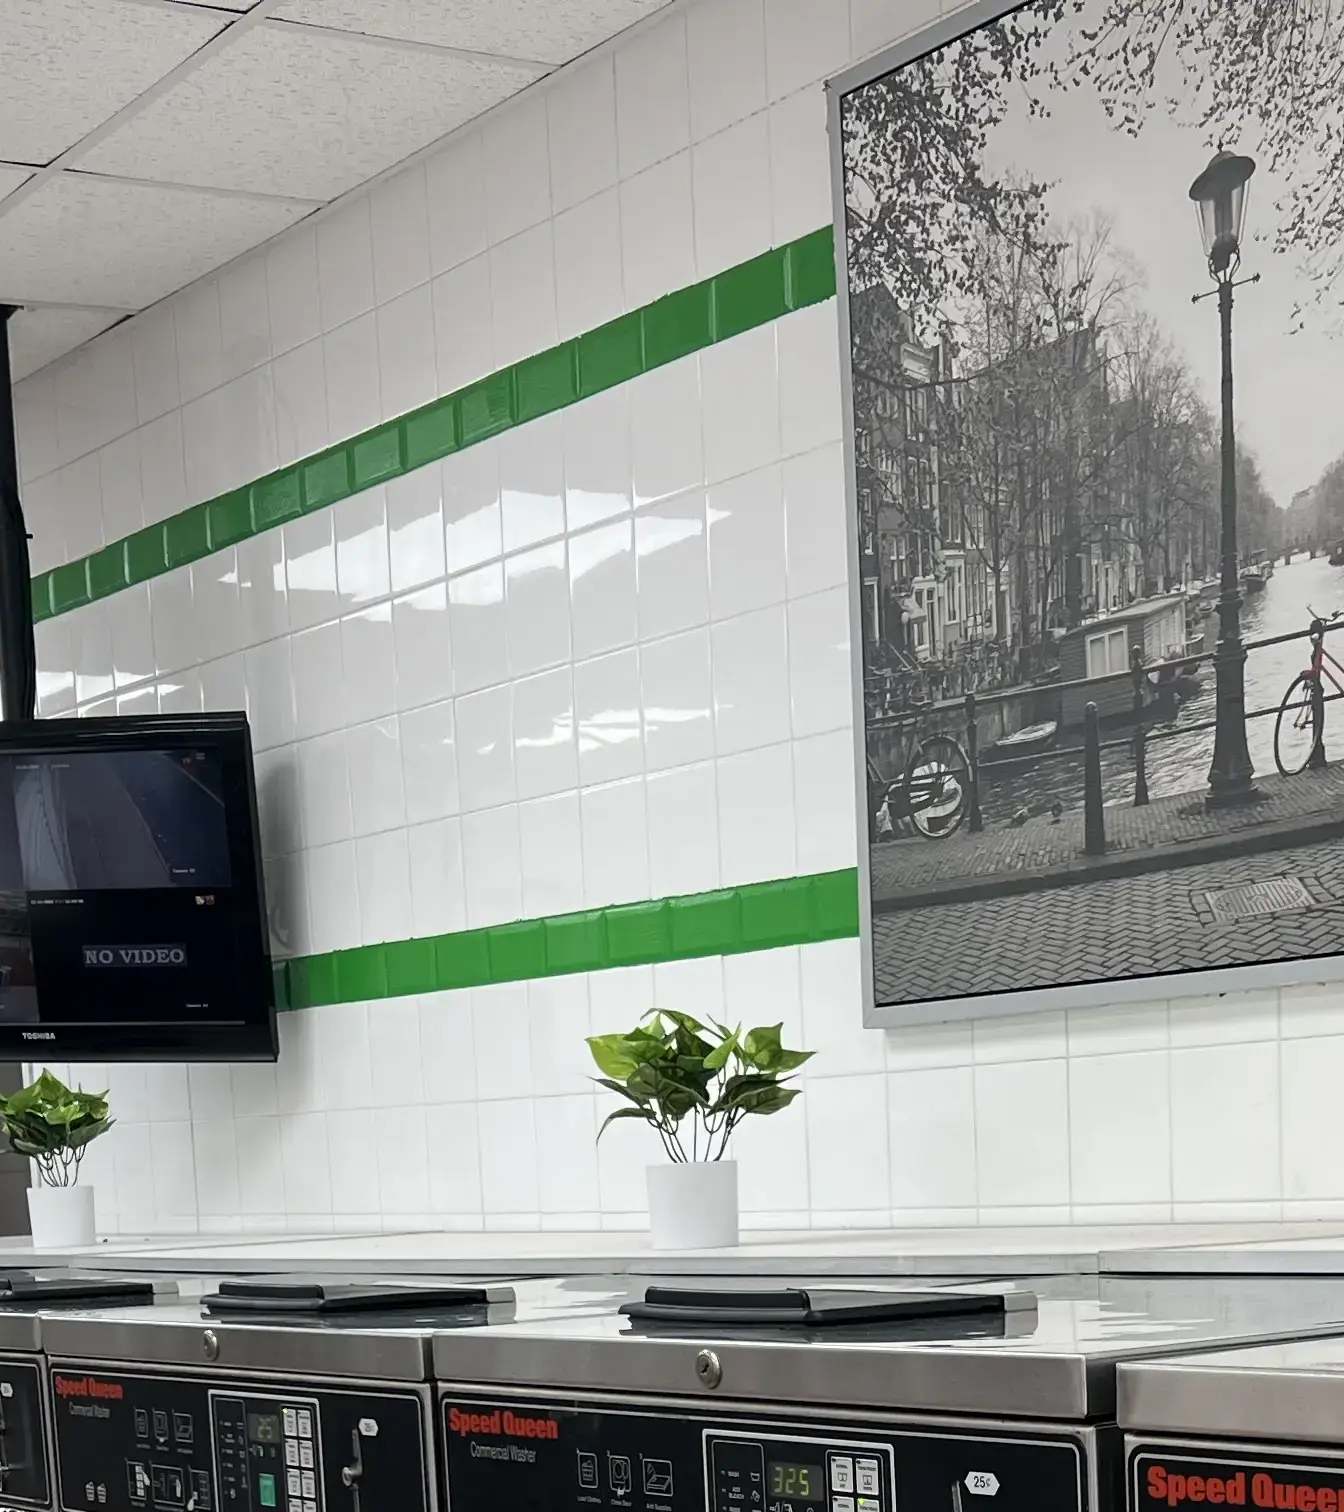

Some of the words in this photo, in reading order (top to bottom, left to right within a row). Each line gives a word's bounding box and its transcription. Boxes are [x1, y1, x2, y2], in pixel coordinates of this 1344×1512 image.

[84, 950, 114, 964] NO
[119, 949, 185, 964] VIDEO
[22, 1032, 56, 1040] TOSHIBA
[56, 1375, 87, 1399] Speed
[449, 1407, 501, 1437] Speed
[503, 1410, 558, 1439] Queen
[470, 1441, 509, 1460] Commercial
[510, 1446, 536, 1463] Washer
[973, 1475, 991, 1488] 25¢
[1147, 1465, 1245, 1507] Speed
